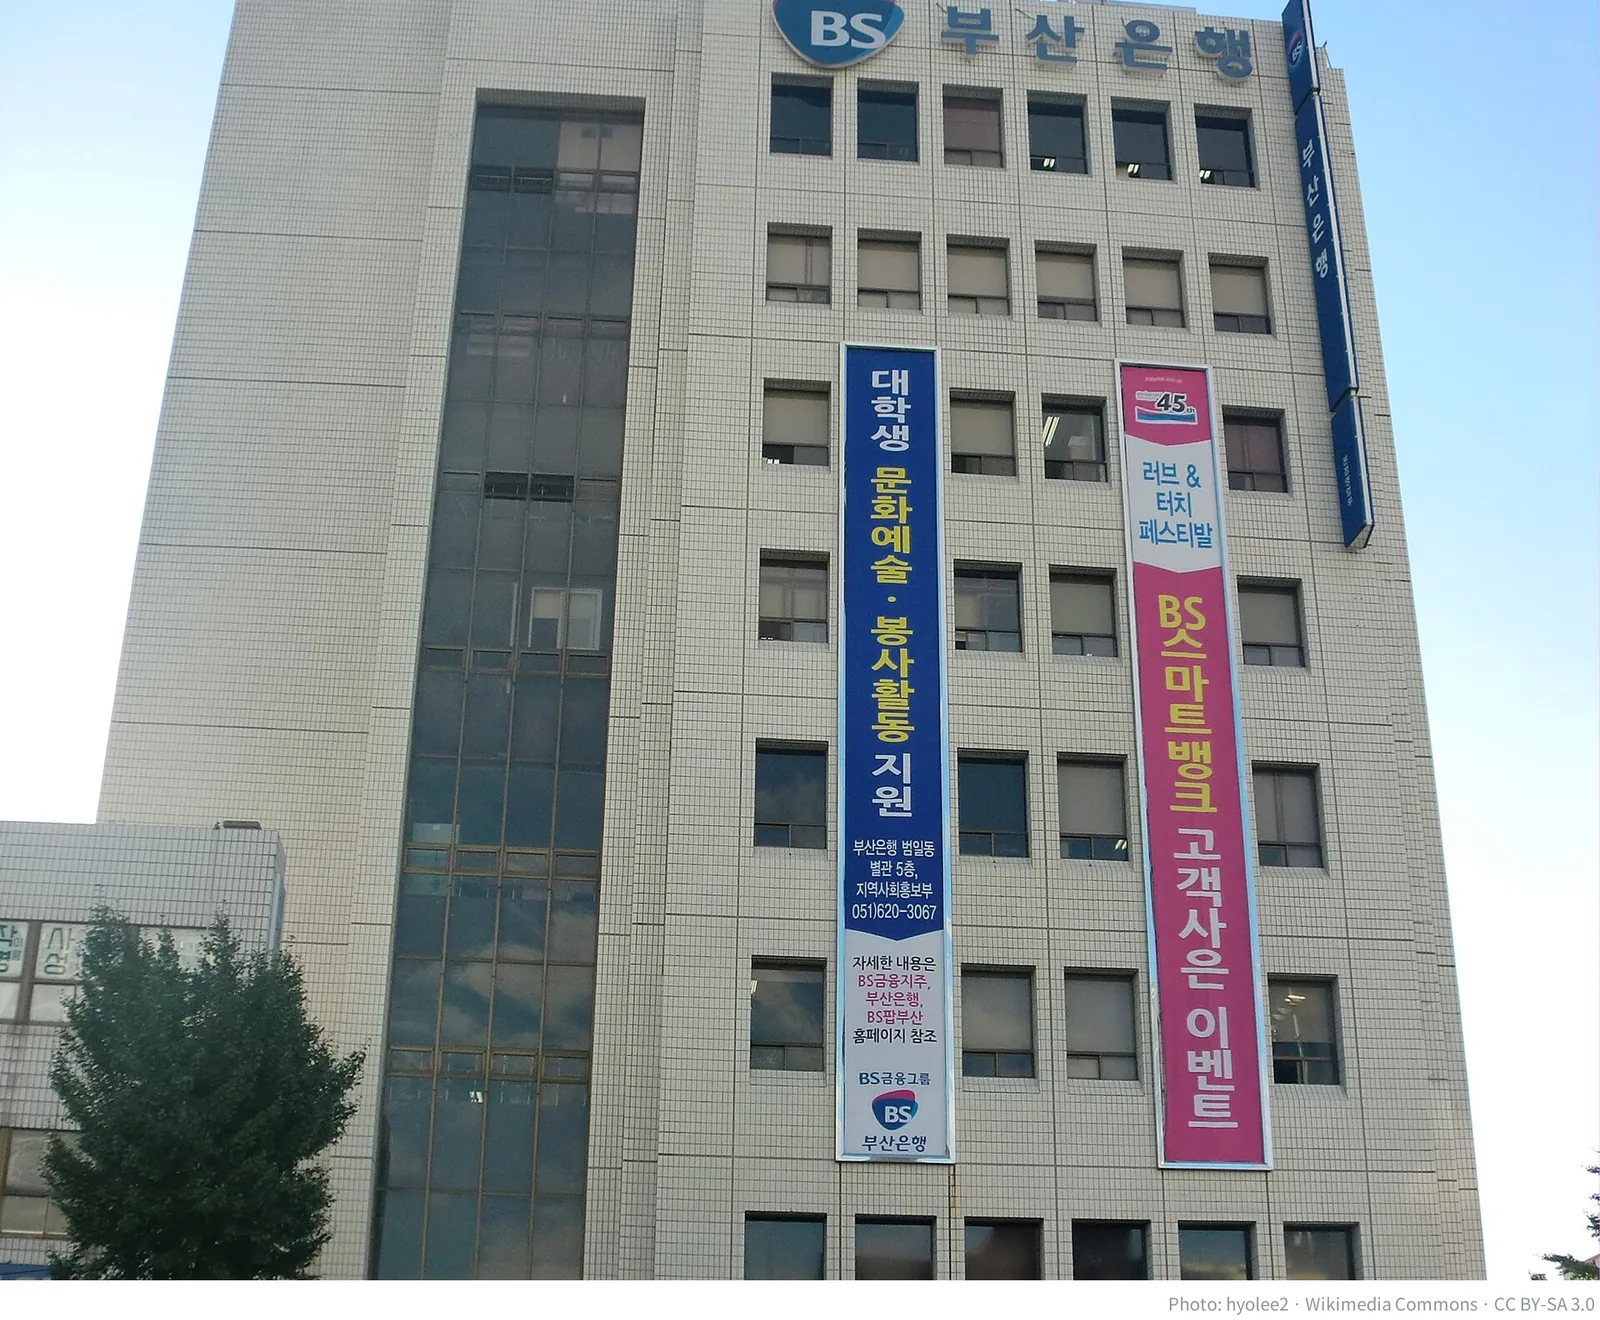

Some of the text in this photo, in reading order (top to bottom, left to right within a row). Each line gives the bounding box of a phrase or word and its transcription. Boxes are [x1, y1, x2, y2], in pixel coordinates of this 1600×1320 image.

[810, 10, 887, 49] BS
[940, 6, 1253, 81] 부산은행
[1302, 139, 1328, 278] 부산은행
[871, 369, 912, 452] 대학생
[1143, 461, 1201, 488] 러브 &
[1156, 491, 1192, 518] 터치
[1139, 519, 1213, 548] 페스티발
[871, 753, 912, 817] 지원
[853, 839, 935, 857] 부산은행 범일동
[870, 860, 918, 879] 별관 5층,
[856, 881, 933, 899] 지역사회홍보부
[852, 902, 937, 920] 051)620-3067
[1173, 828, 1229, 990] 고객사은
[853, 955, 936, 972] 자세한 내용은
[858, 973, 931, 990] BS금융지주,
[866, 991, 923, 1008] 부산은행,
[867, 1010, 923, 1025] BS팝부산
[853, 1027, 937, 1044] 홈페이지 참조
[1186, 1006, 1238, 1128] 이벤트
[859, 1072, 930, 1086] BS금융그룹
[884, 1105, 912, 1123] BS
[862, 1135, 927, 1152] 부산은행
